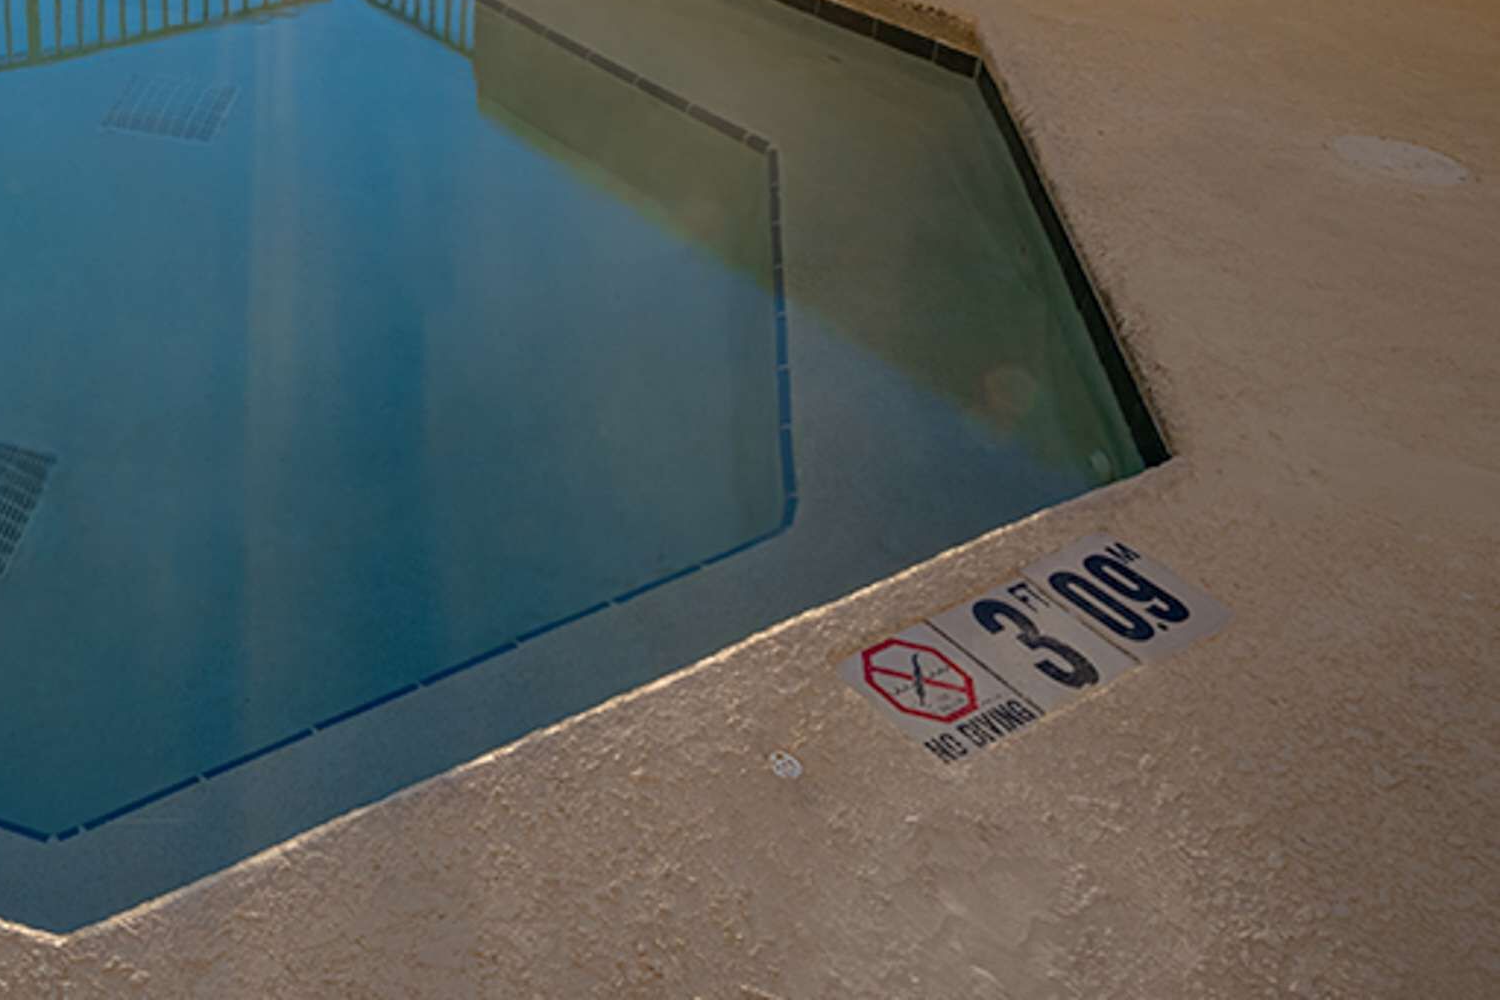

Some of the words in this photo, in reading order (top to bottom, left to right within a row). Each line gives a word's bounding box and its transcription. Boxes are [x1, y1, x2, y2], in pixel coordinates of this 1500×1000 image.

[972, 599, 1099, 690] 3
[923, 733, 969, 764] NO
[955, 699, 1038, 748] DIVING
